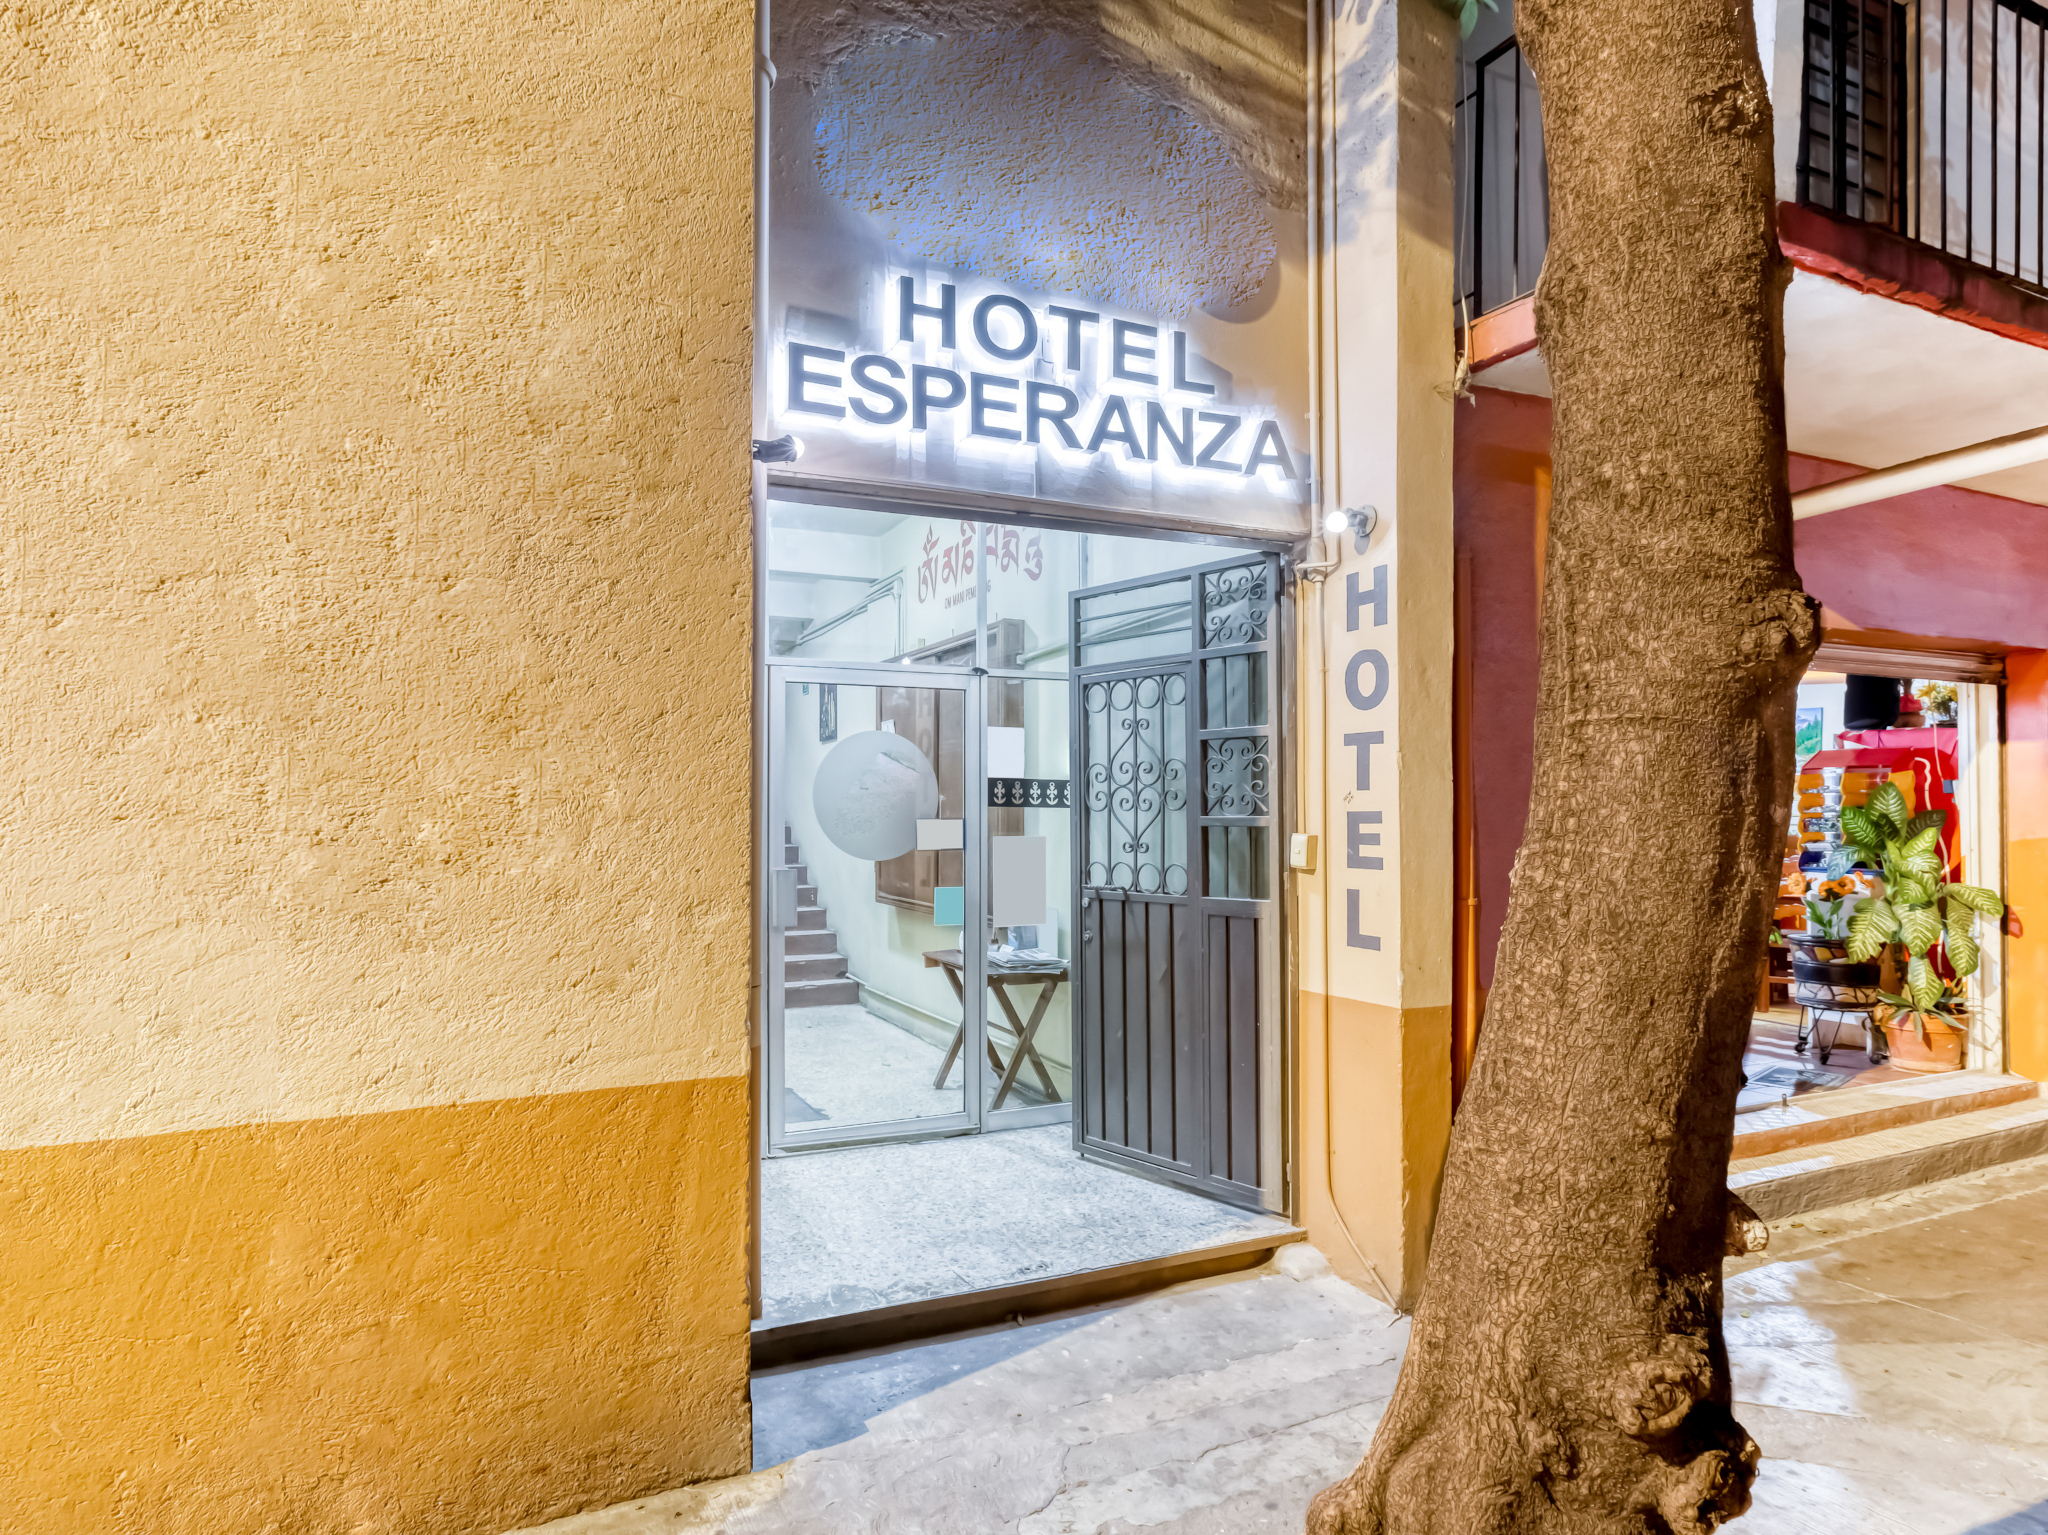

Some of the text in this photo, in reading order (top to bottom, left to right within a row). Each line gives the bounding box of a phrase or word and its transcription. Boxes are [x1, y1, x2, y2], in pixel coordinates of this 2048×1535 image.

[899, 275, 1216, 396] HOTEL
[787, 342, 1298, 479] ESPERANZA
[1343, 564, 1390, 952] HOTEL
